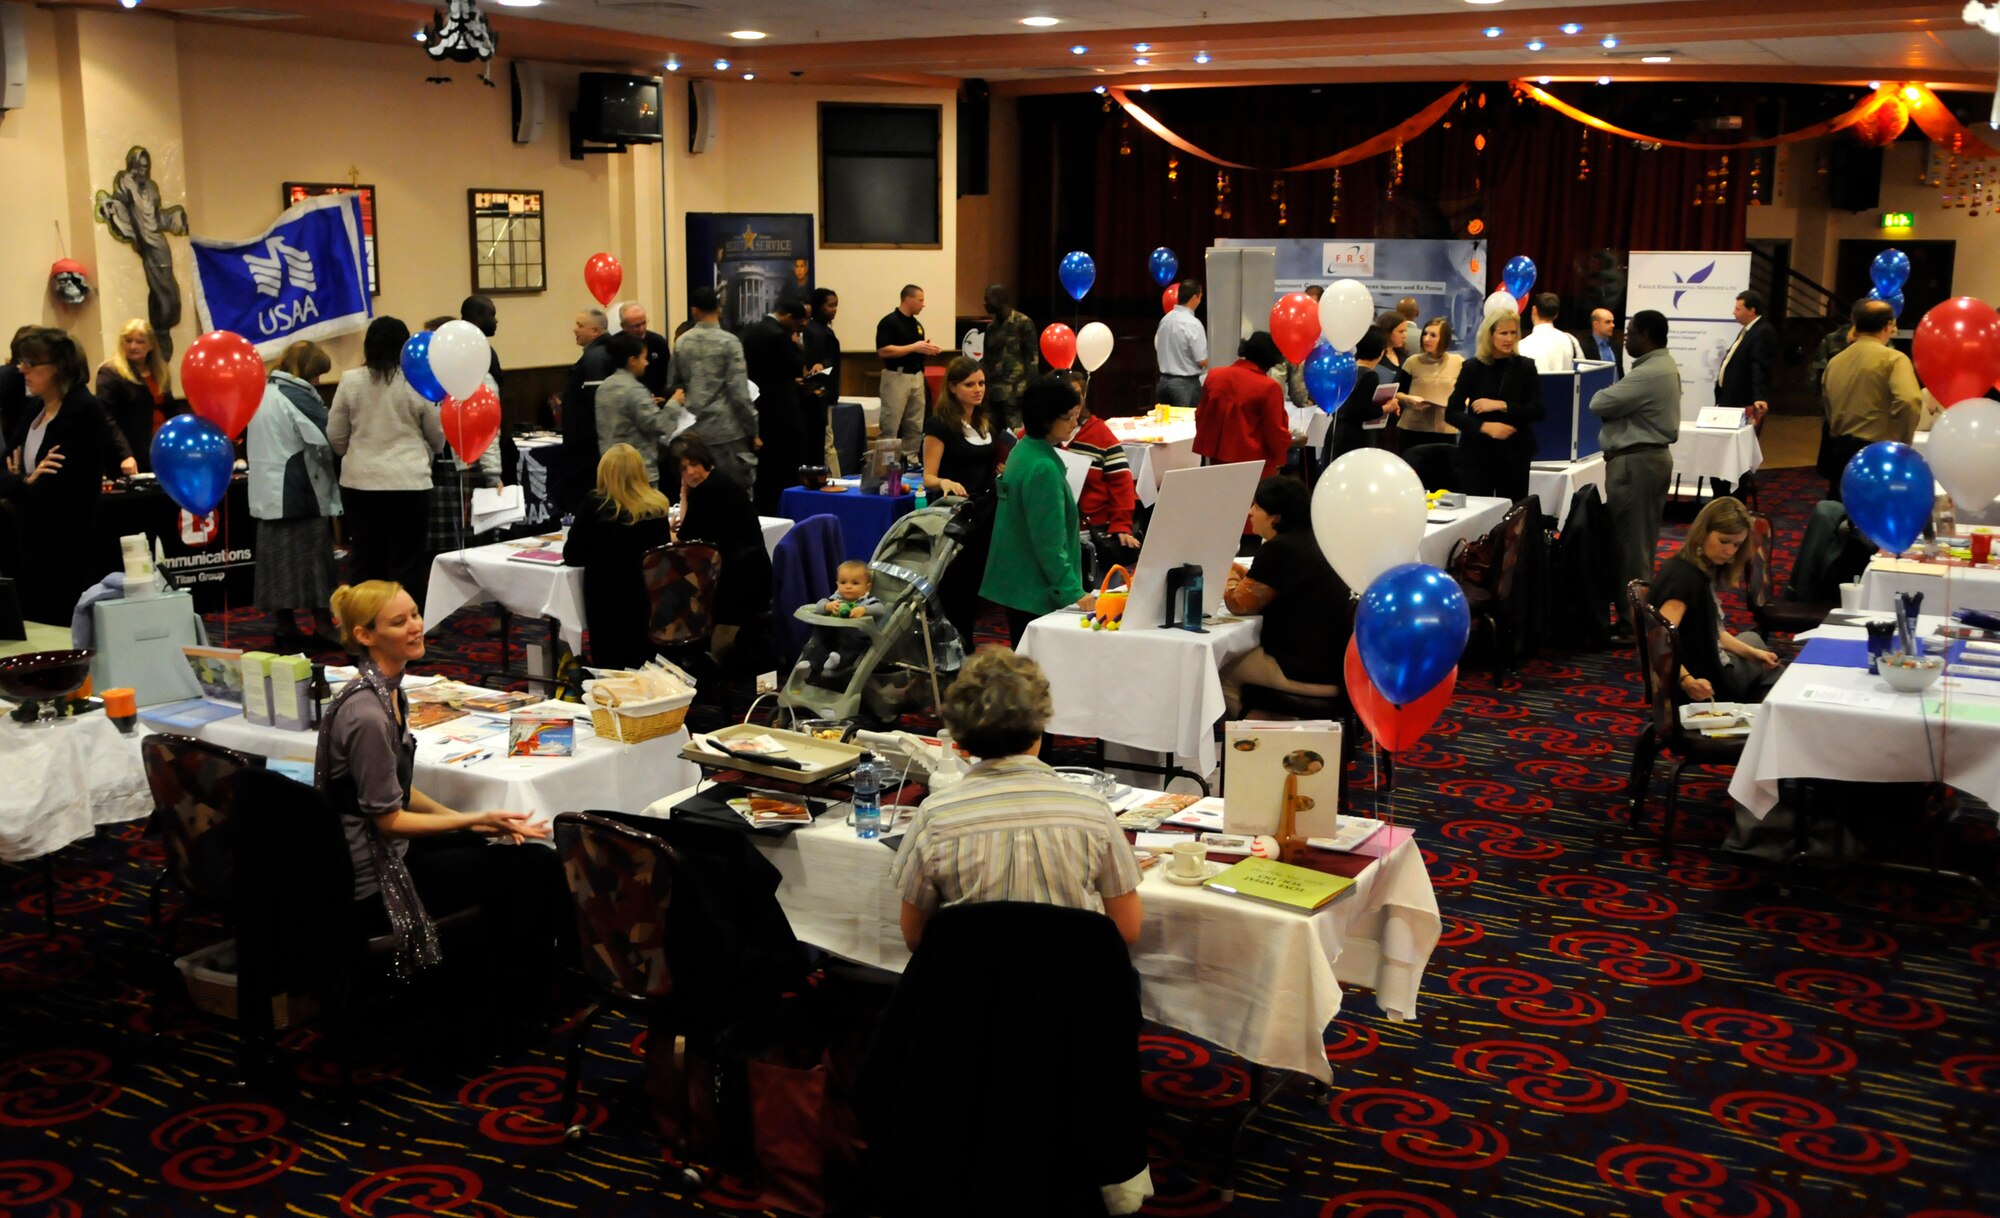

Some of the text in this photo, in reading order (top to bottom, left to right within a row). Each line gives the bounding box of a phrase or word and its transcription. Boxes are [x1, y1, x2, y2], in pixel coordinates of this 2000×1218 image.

[756, 240, 792, 251] SERVICE
[258, 294, 319, 335] USAA
[164, 548, 252, 569] mmunications
[175, 572, 225, 585] Titan Group
[1243, 876, 1304, 892] LOVE WHAT
